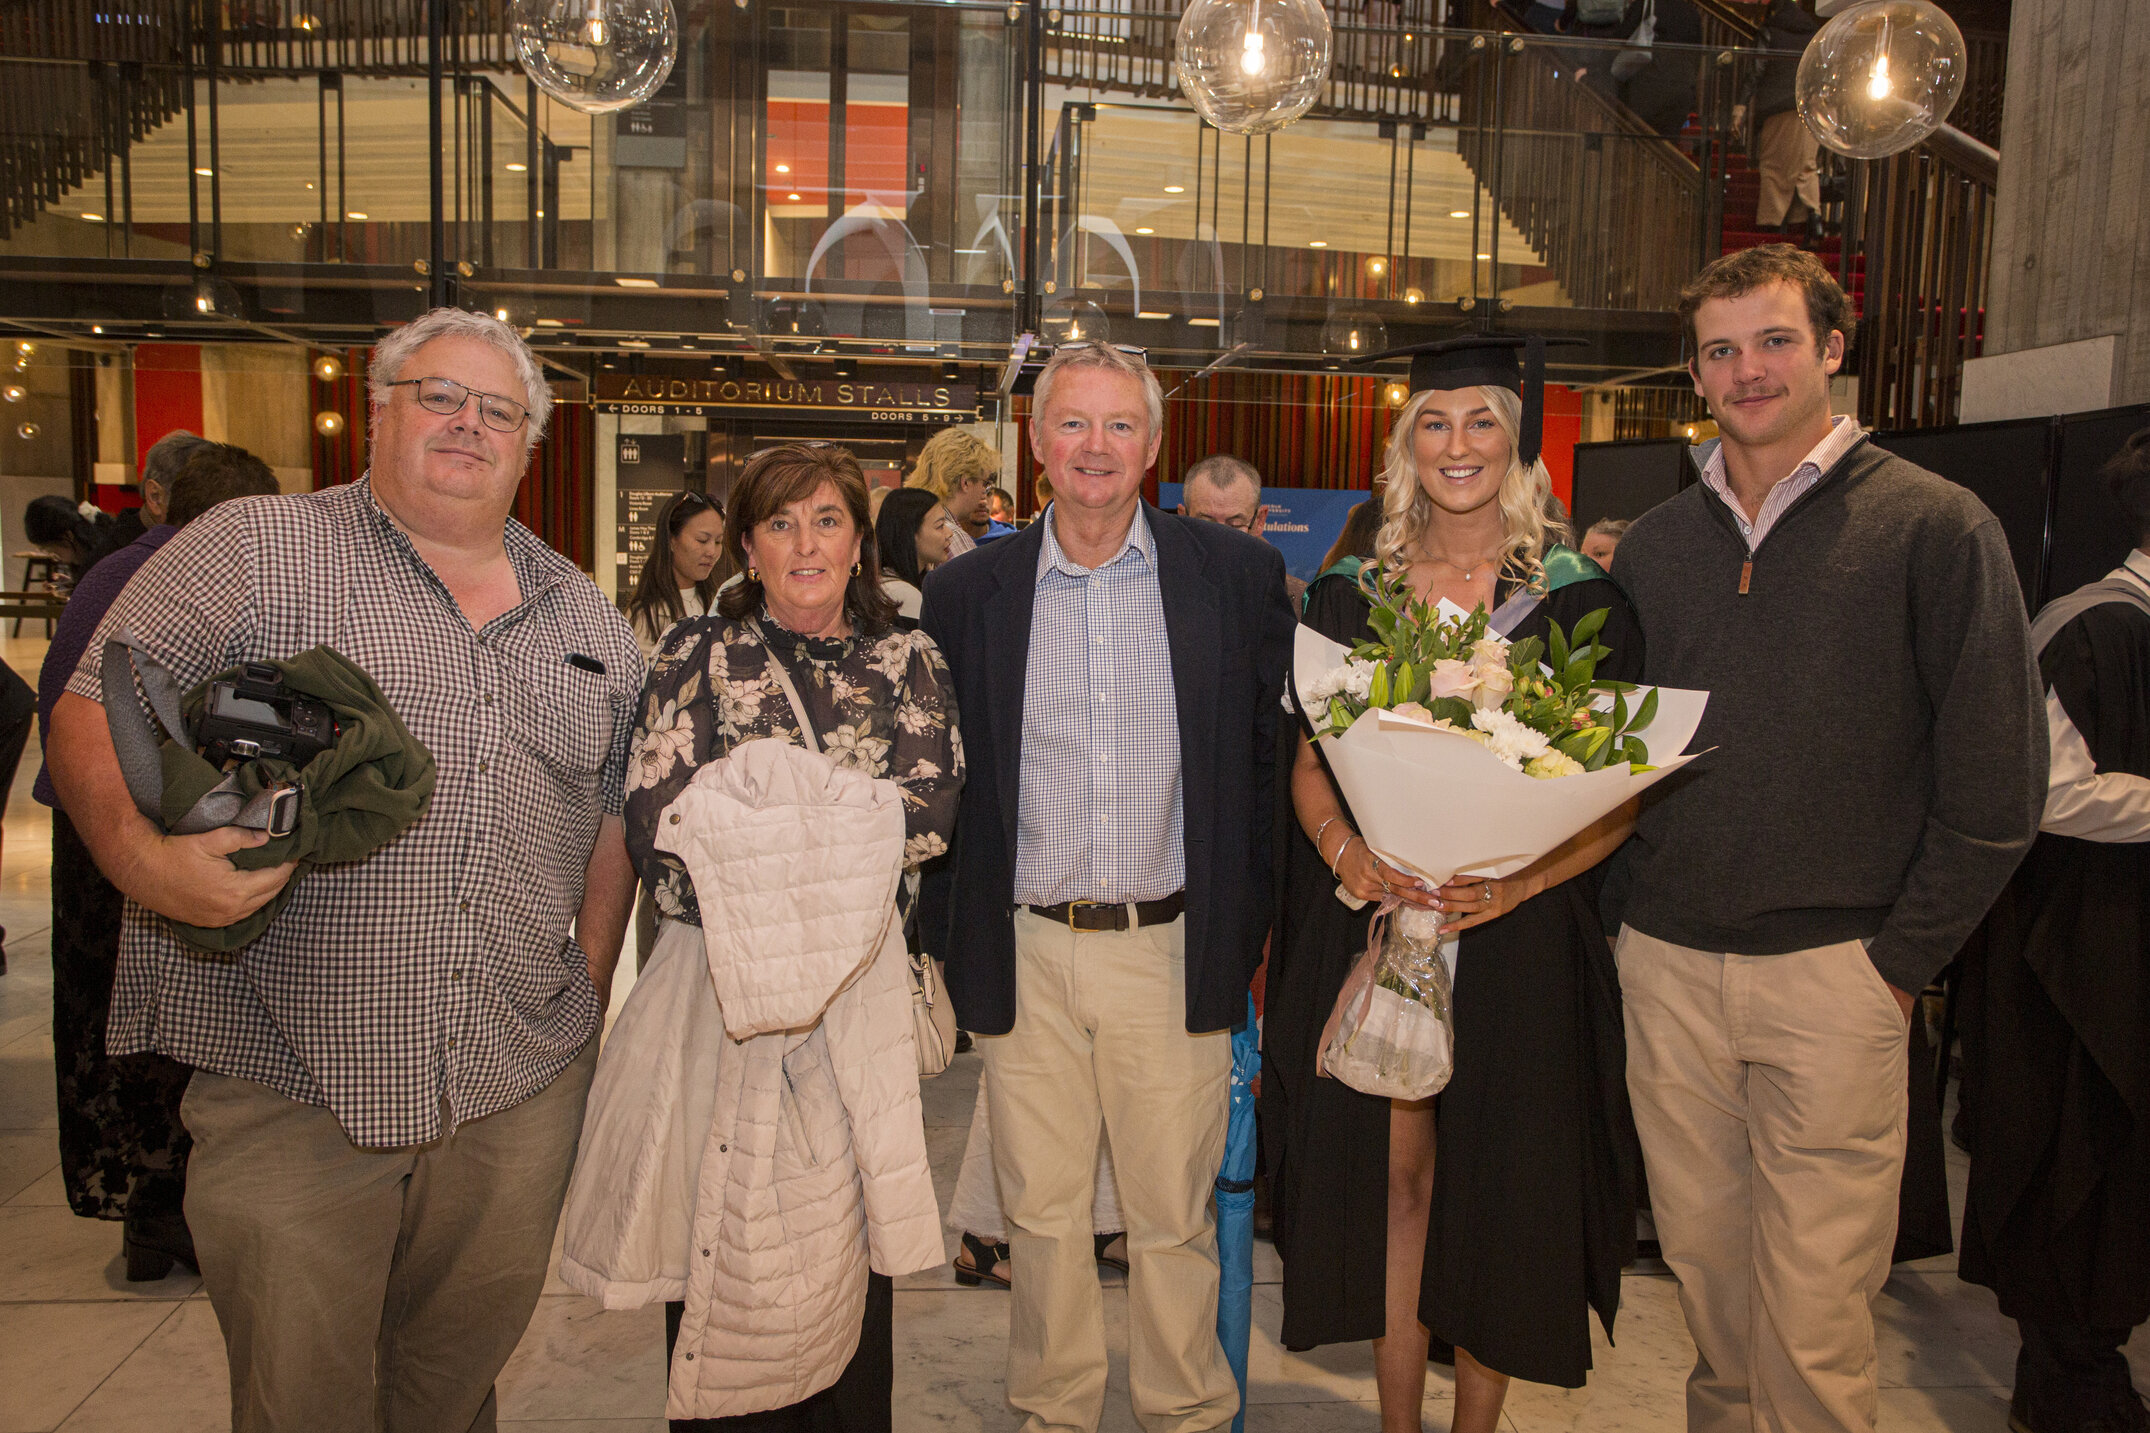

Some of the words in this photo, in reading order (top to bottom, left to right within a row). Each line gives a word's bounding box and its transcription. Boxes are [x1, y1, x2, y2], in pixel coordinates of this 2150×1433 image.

[623, 379, 822, 403] AUDITORIUM
[837, 384, 951, 407] STALLS
[622, 404, 666, 415] DOORS
[675, 407, 680, 415] 1
[696, 407, 703, 415] 5
[871, 412, 913, 421] DOORS
[922, 414, 929, 422] 5
[1264, 521, 1309, 533] tulations
